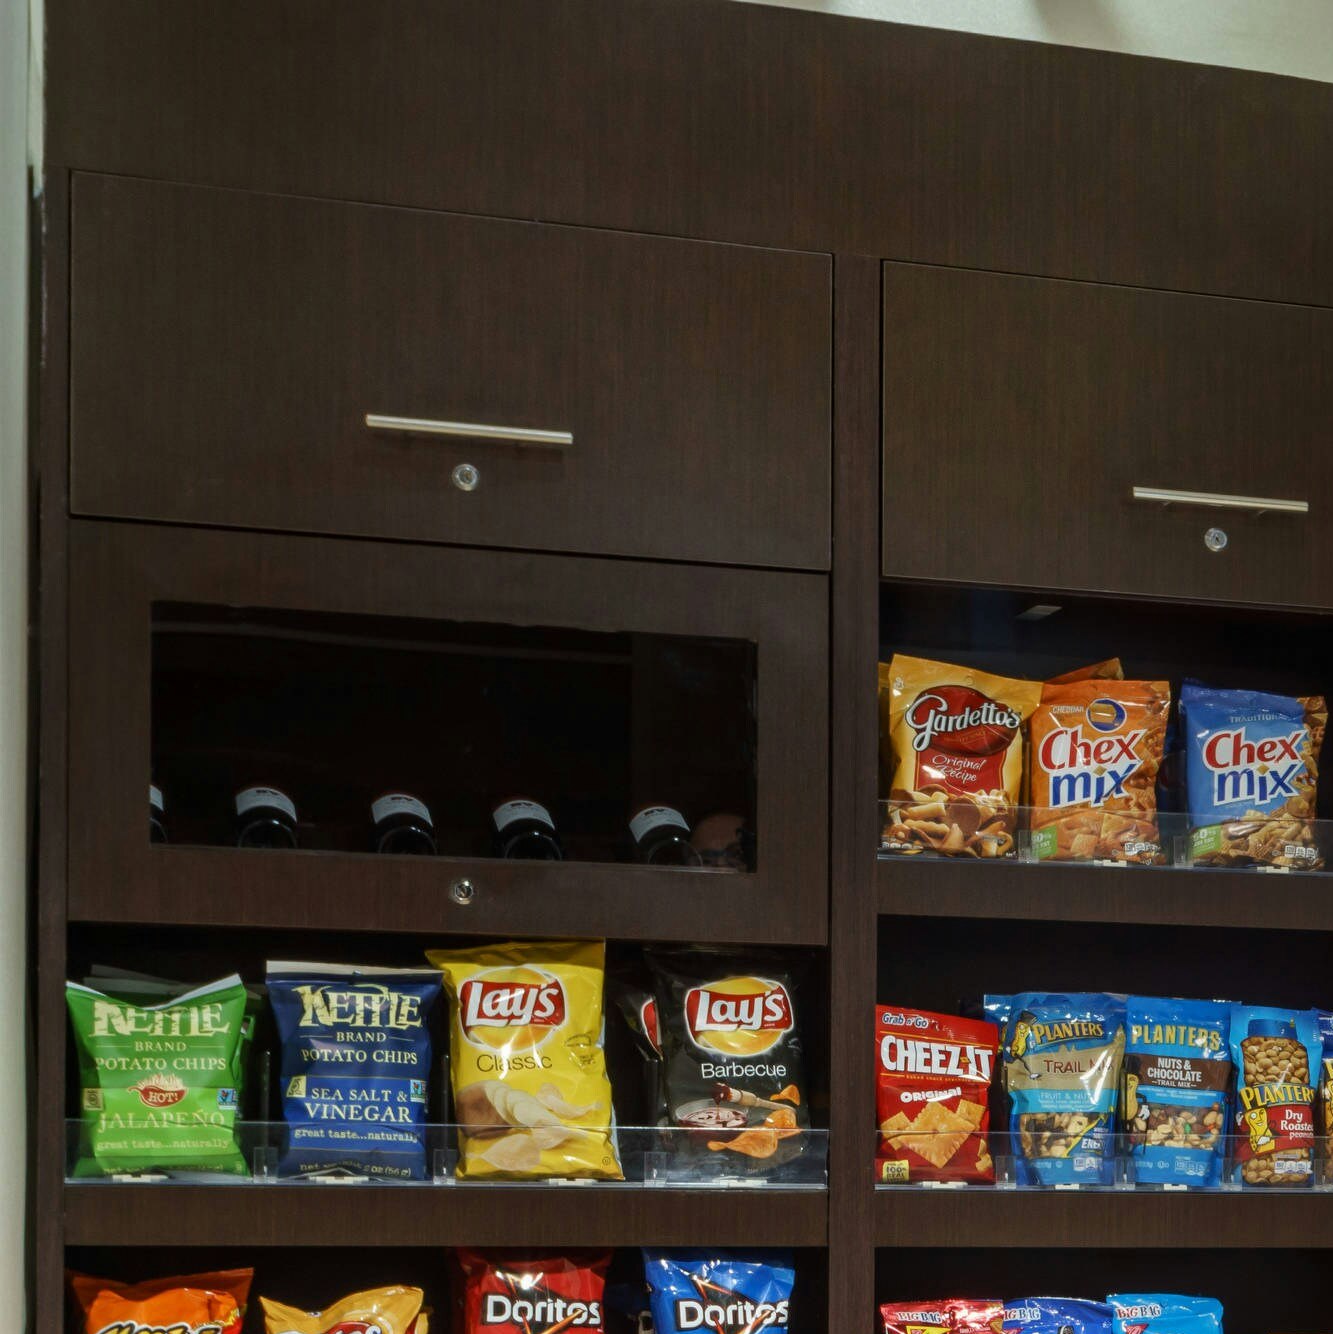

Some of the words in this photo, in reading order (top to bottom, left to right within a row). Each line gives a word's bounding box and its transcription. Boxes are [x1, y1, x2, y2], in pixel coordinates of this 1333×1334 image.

[905, 694, 1022, 751] Gardetto's
[1039, 728, 1140, 771] Chex
[1204, 732, 1302, 769] Chex
[932, 754, 986, 772] Original
[938, 767, 978, 782] Recipe
[1052, 763, 1137, 808] mix
[1217, 763, 1298, 805] mix
[291, 984, 422, 1029] KETTLE
[466, 982, 559, 1028] Lay's
[696, 989, 785, 1031] Lay's
[882, 1013, 904, 1025] Grab
[915, 1016, 929, 1028] Go
[336, 1032, 387, 1042] BRAND
[1032, 1023, 1103, 1045] PLANTERS
[1131, 1025, 1220, 1051] PLANTERS
[134, 1041, 187, 1052] BRAND
[95, 1058, 167, 1070] POTATO
[172, 1057, 226, 1070] CHIPS
[302, 1049, 367, 1062] POTATO
[372, 1050, 417, 1065] CHIPS
[1158, 1058, 1182, 1068] NUTS
[1184, 1059, 1191, 1070] &
[701, 1062, 787, 1079] Barbecue
[1044, 1060, 1086, 1074] TRAIL
[1148, 1068, 1201, 1082] CHOCOLATE
[311, 1088, 343, 1101] SEA
[349, 1089, 392, 1102] SALT
[397, 1091, 407, 1102] &
[99, 1108, 224, 1132] JALAPEÑO
[305, 1103, 413, 1122] VINEGAR
[1285, 1109, 1303, 1122] Dry
[486, 1294, 601, 1325] Doritos
[678, 1300, 789, 1331] Doritos
[1116, 1307, 1137, 1319] BIG
[1138, 1304, 1160, 1317] BAG
